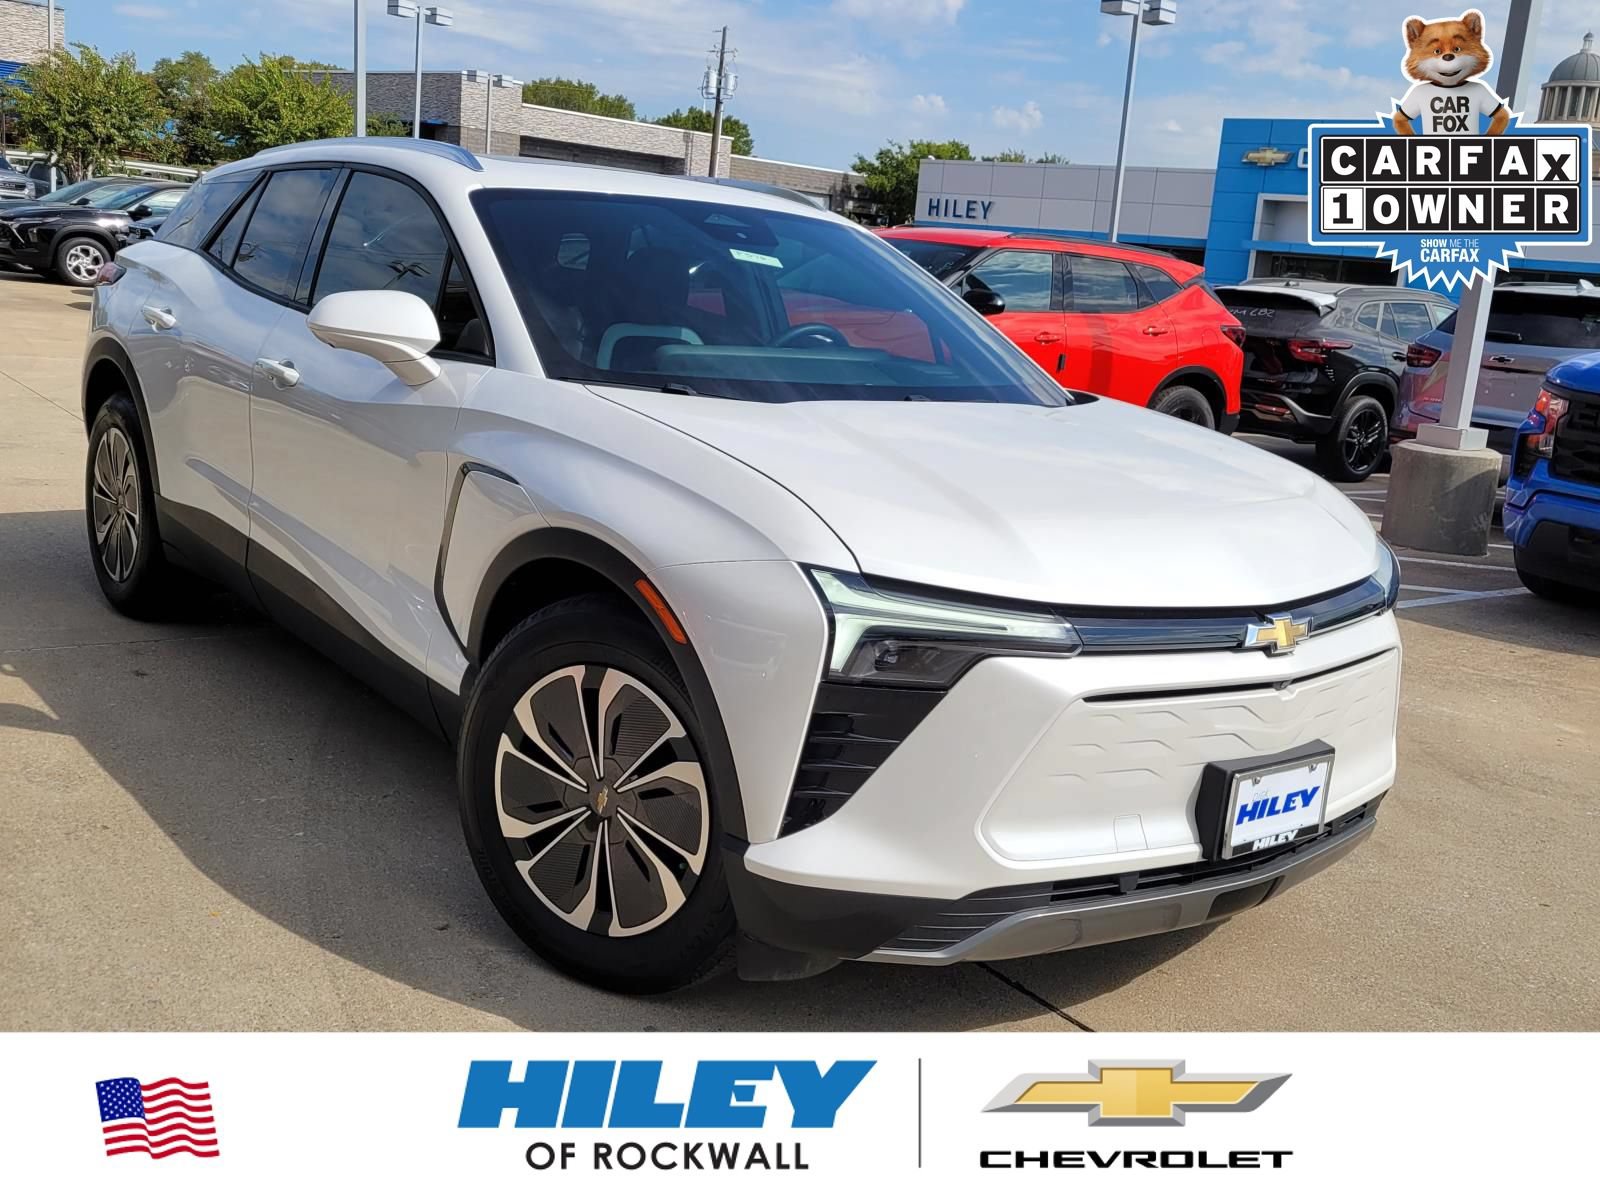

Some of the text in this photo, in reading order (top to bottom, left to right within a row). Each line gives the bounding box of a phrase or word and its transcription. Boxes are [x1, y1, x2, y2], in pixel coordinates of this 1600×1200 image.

[928, 198, 992, 220] HILEY
[1235, 785, 1320, 826] HILEY
[1252, 829, 1299, 851] HILEY
